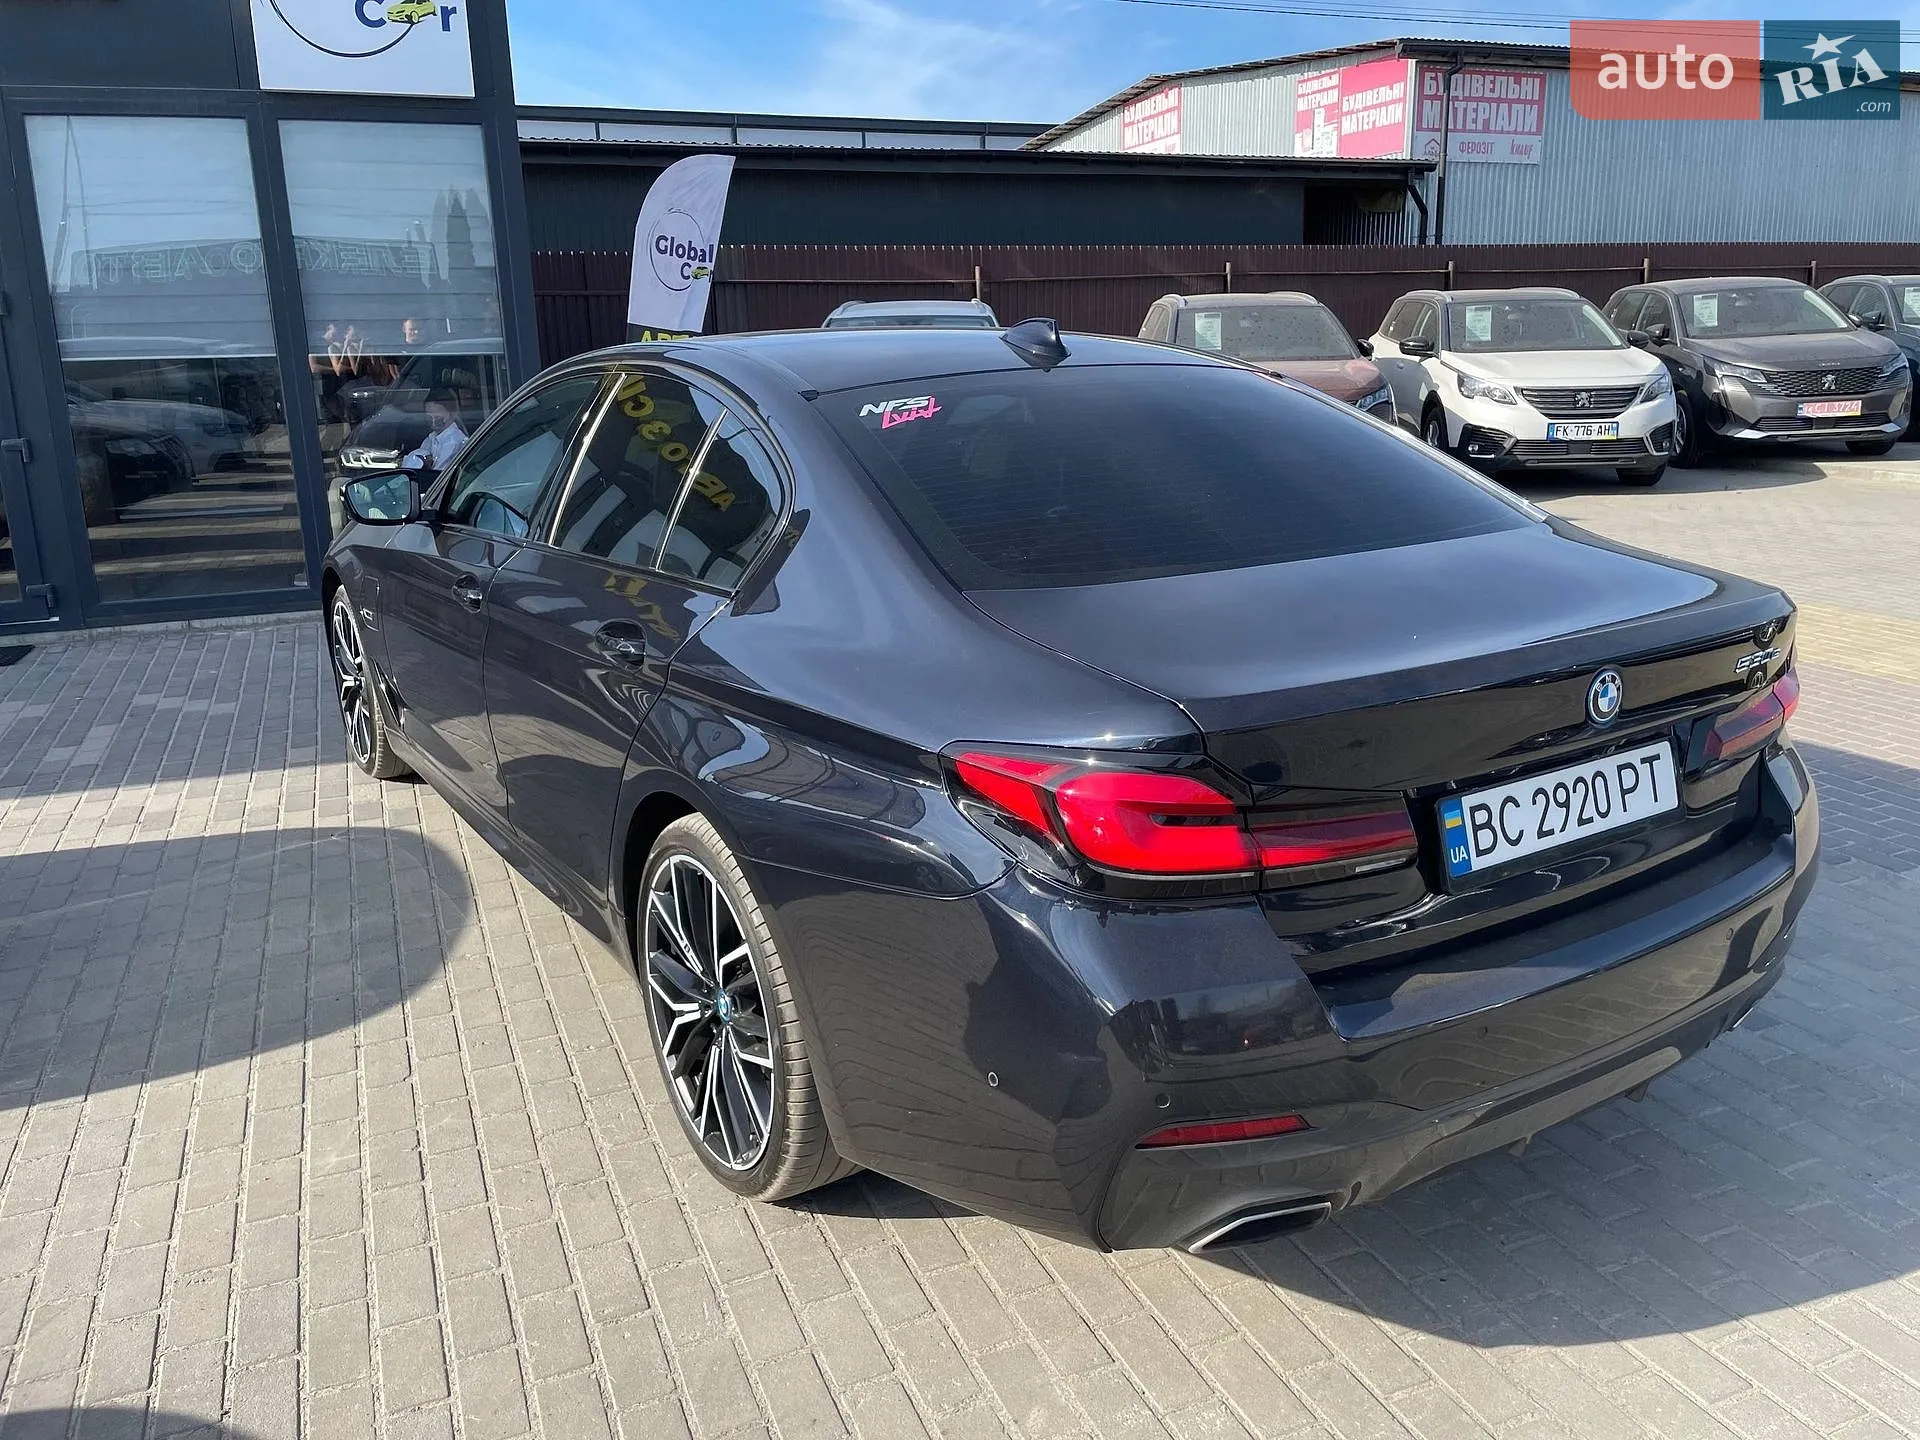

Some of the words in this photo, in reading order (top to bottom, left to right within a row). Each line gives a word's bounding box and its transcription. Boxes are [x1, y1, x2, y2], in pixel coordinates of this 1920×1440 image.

[354, 0, 457, 32] Cr
[1342, 81, 1405, 113] БУДІВЕЛЬНІ
[1341, 102, 1404, 136] МАТЕРІАЛИ
[655, 234, 714, 263] Global
[859, 395, 933, 417] NFS
[1469, 795, 1524, 858] BC
[1531, 770, 1612, 840] 2920
[1616, 753, 1661, 813] PT
[1450, 847, 1469, 864] UA
